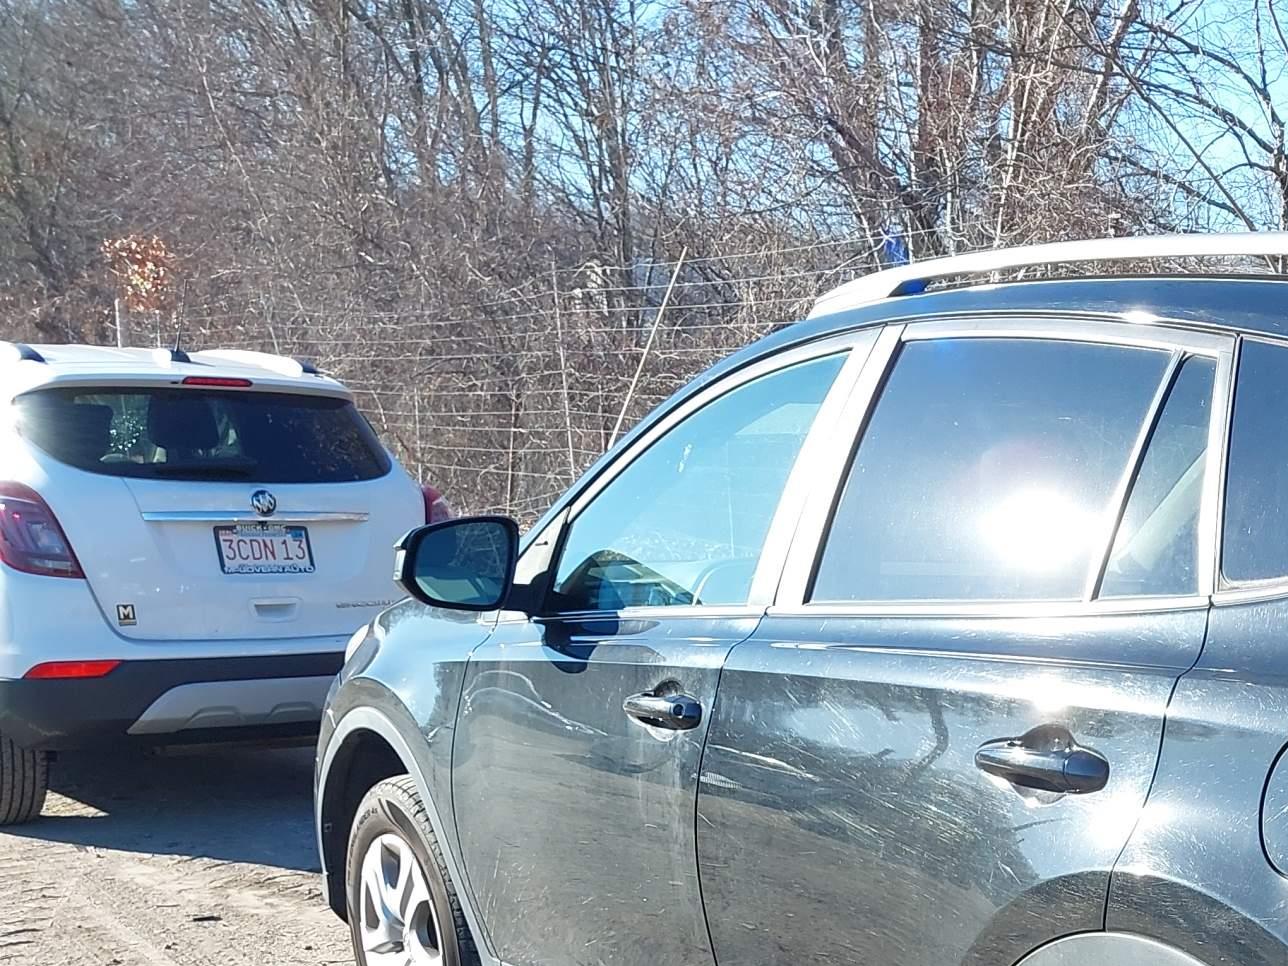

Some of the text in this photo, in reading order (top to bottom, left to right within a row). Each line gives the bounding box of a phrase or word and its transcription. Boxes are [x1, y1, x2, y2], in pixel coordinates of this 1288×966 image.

[222, 538, 306, 561] 3CDN 13
[118, 605, 134, 619] M
